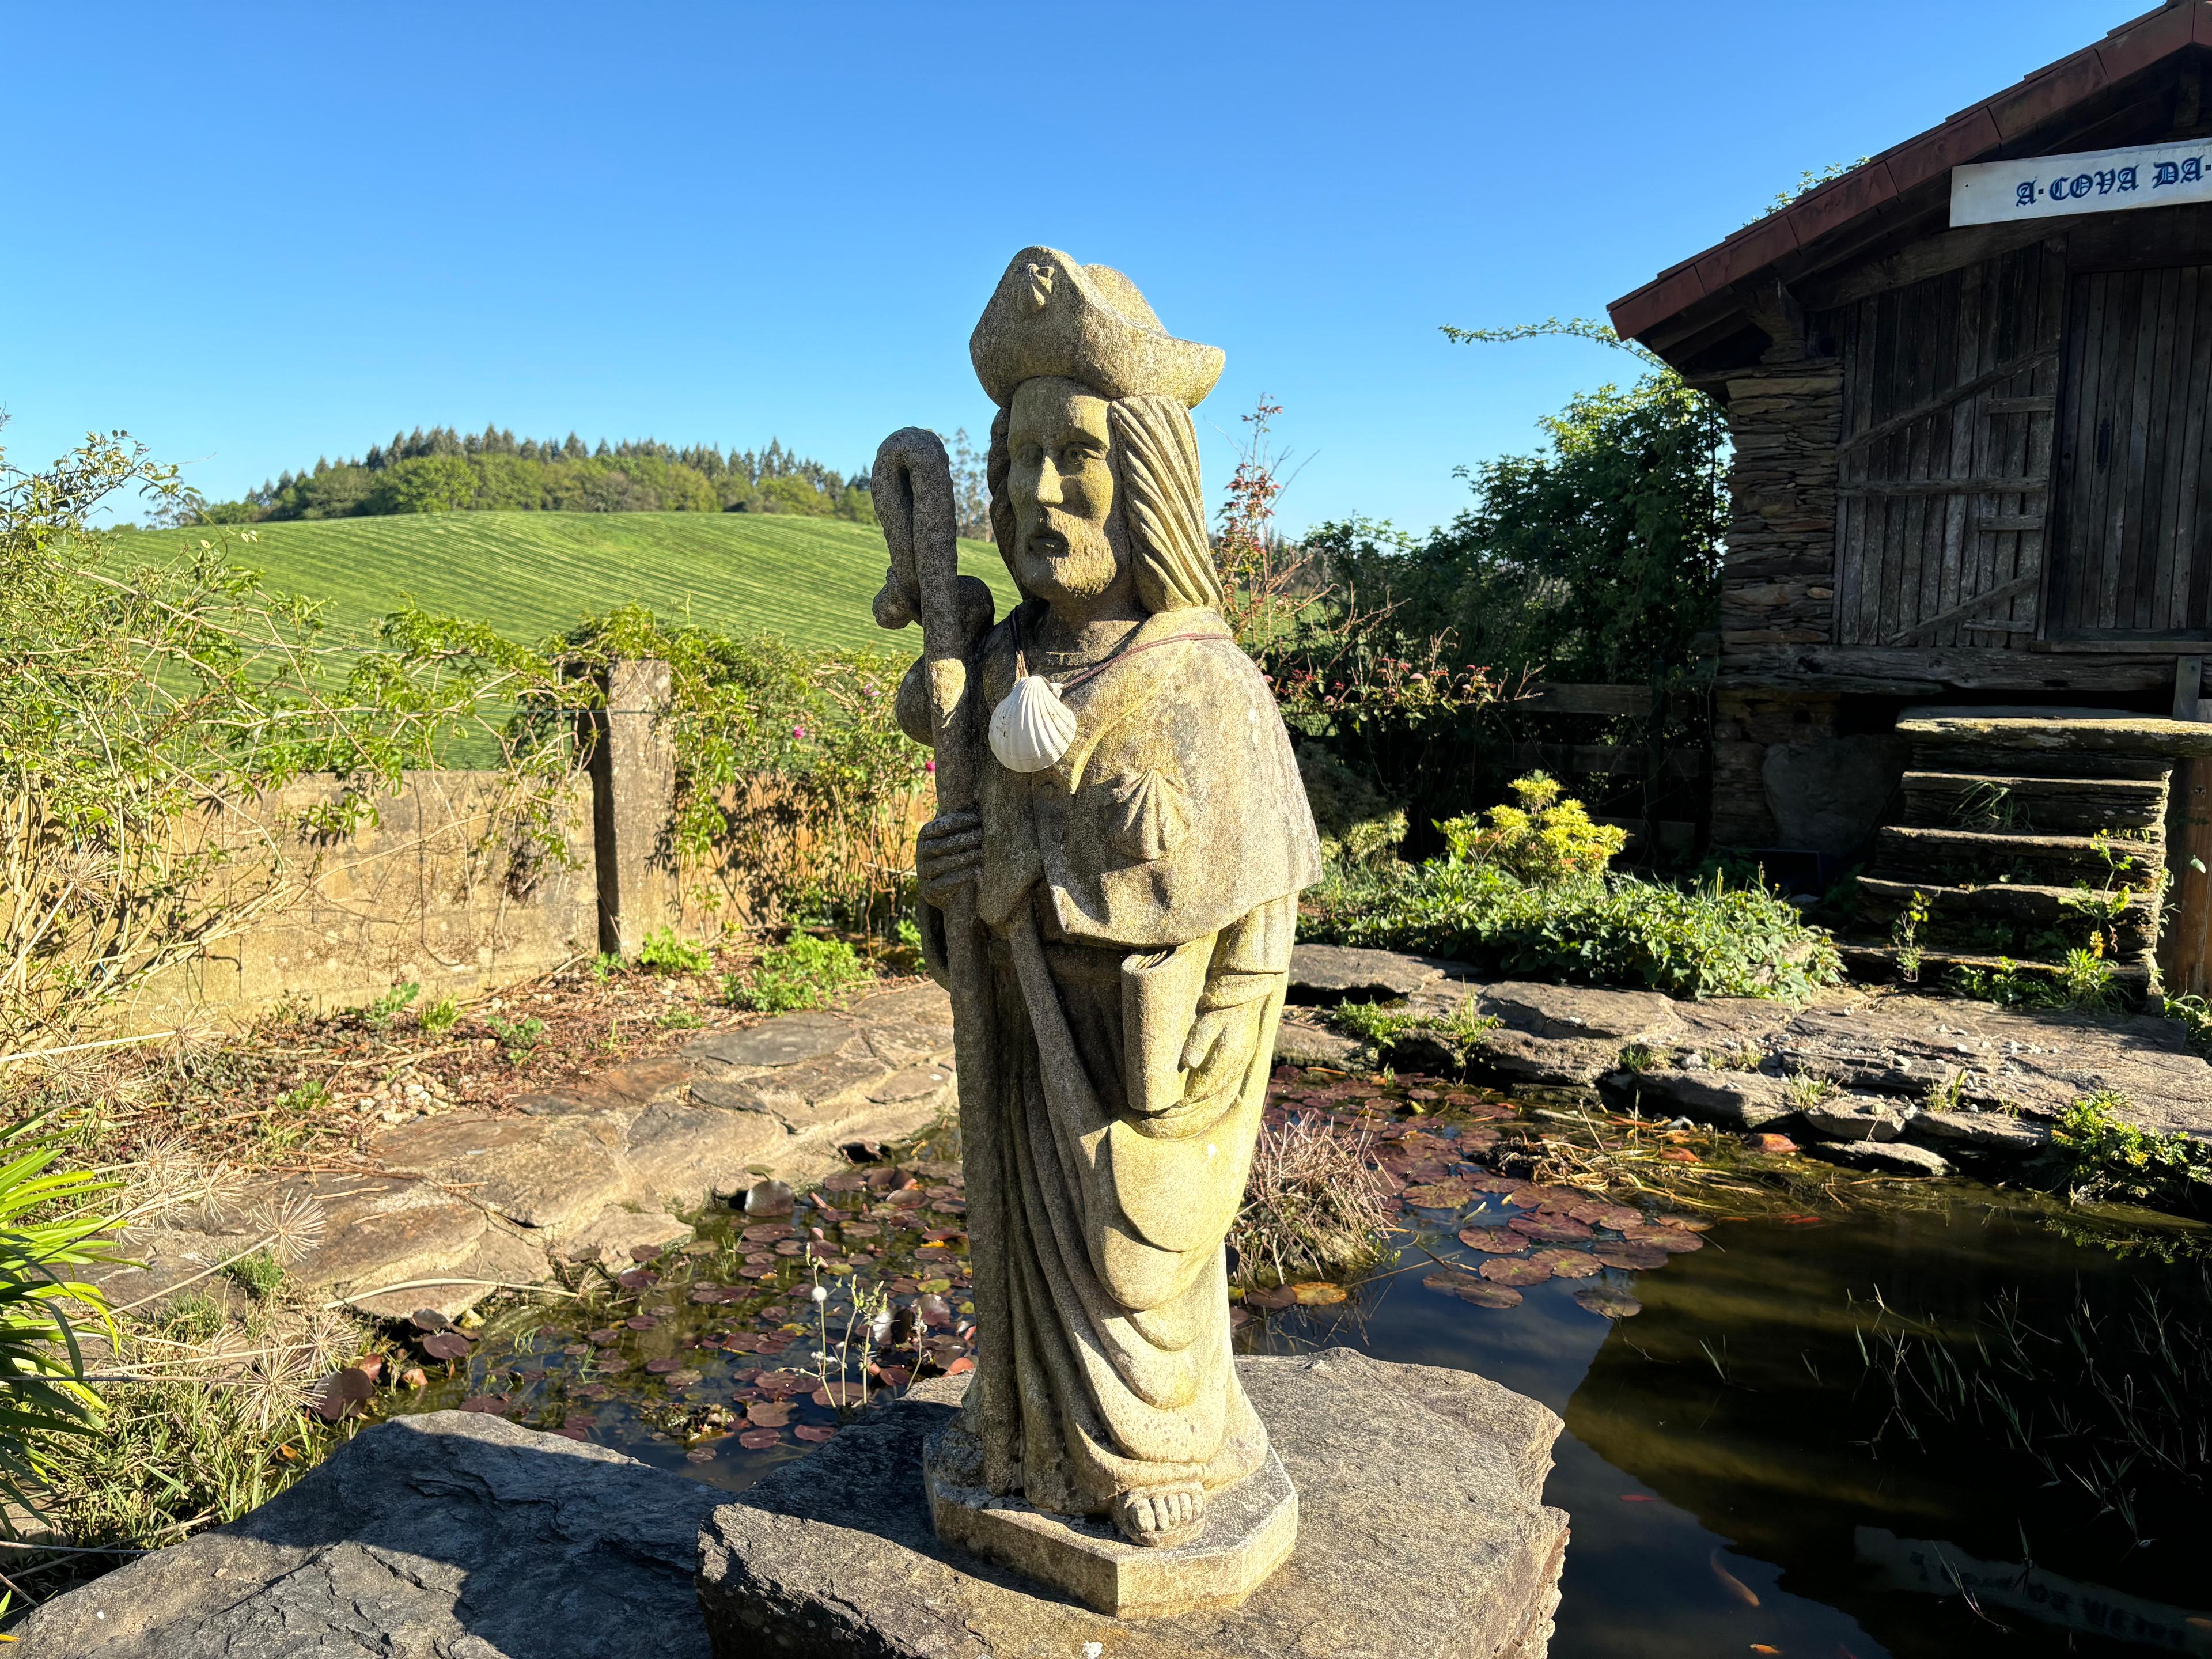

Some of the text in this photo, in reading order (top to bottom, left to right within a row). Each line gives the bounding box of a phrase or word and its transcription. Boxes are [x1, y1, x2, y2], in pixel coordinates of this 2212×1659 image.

[2016, 155, 2205, 207] A COVA DA
